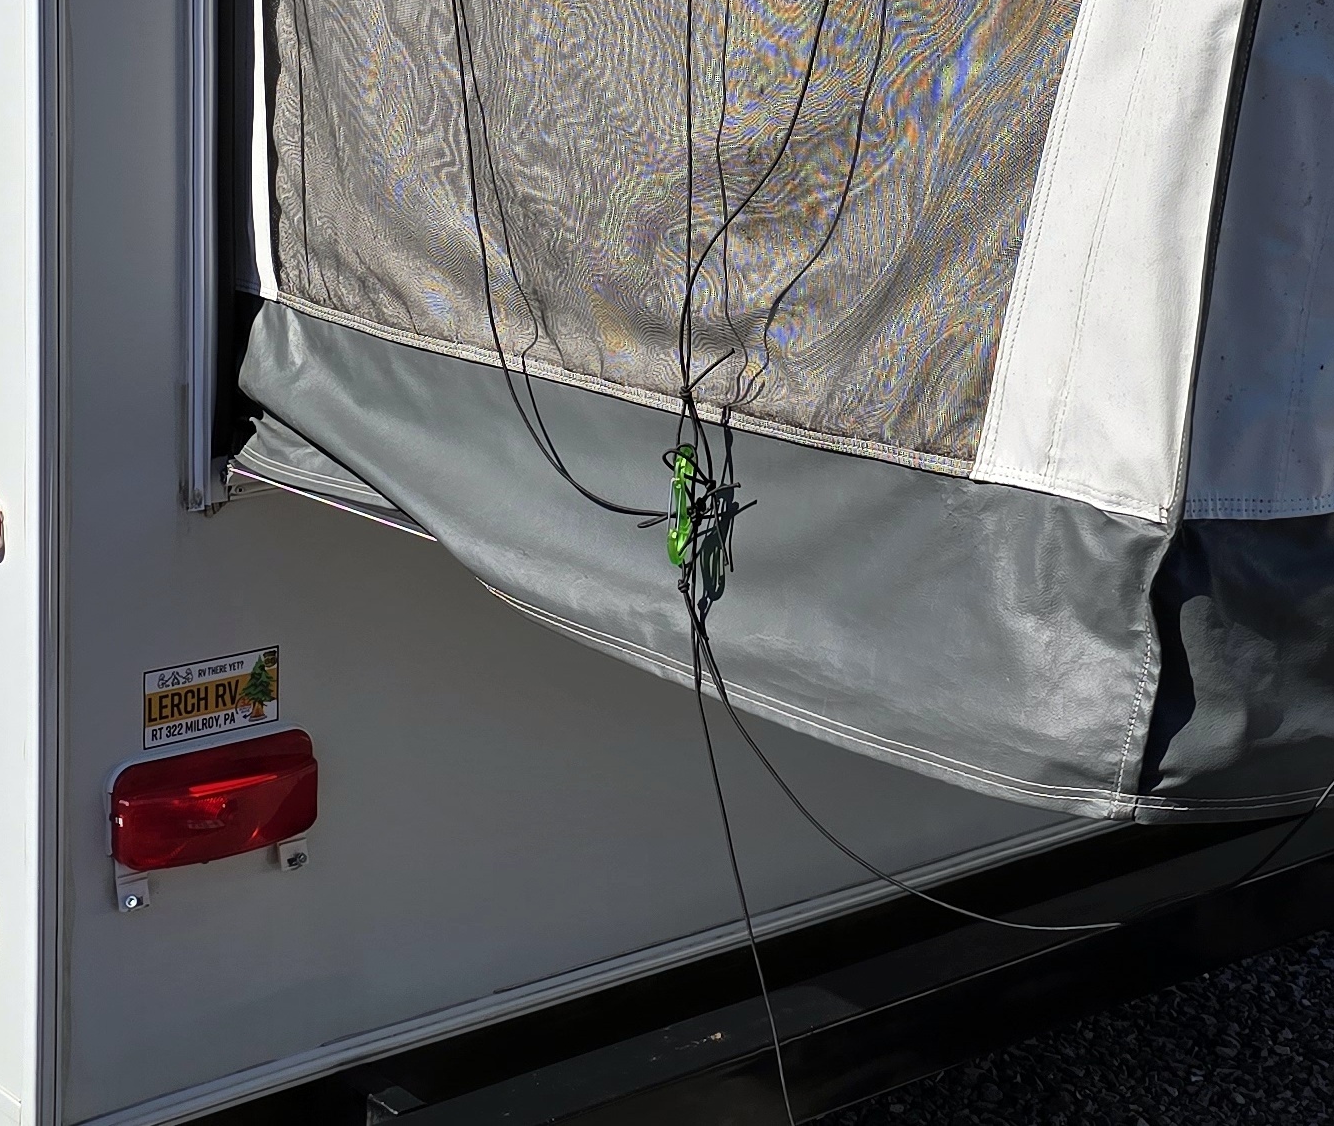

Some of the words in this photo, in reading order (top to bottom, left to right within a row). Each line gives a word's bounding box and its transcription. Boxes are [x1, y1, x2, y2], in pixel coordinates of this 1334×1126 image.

[197, 668, 207, 678] RV
[207, 663, 228, 676] THERE
[228, 660, 244, 672] YET?
[147, 686, 209, 723] LERCH
[215, 679, 240, 709] RV
[151, 727, 164, 741] RT
[166, 722, 183, 739] 322
[185, 715, 222, 734] MILROY,
[223, 712, 236, 726] PA
